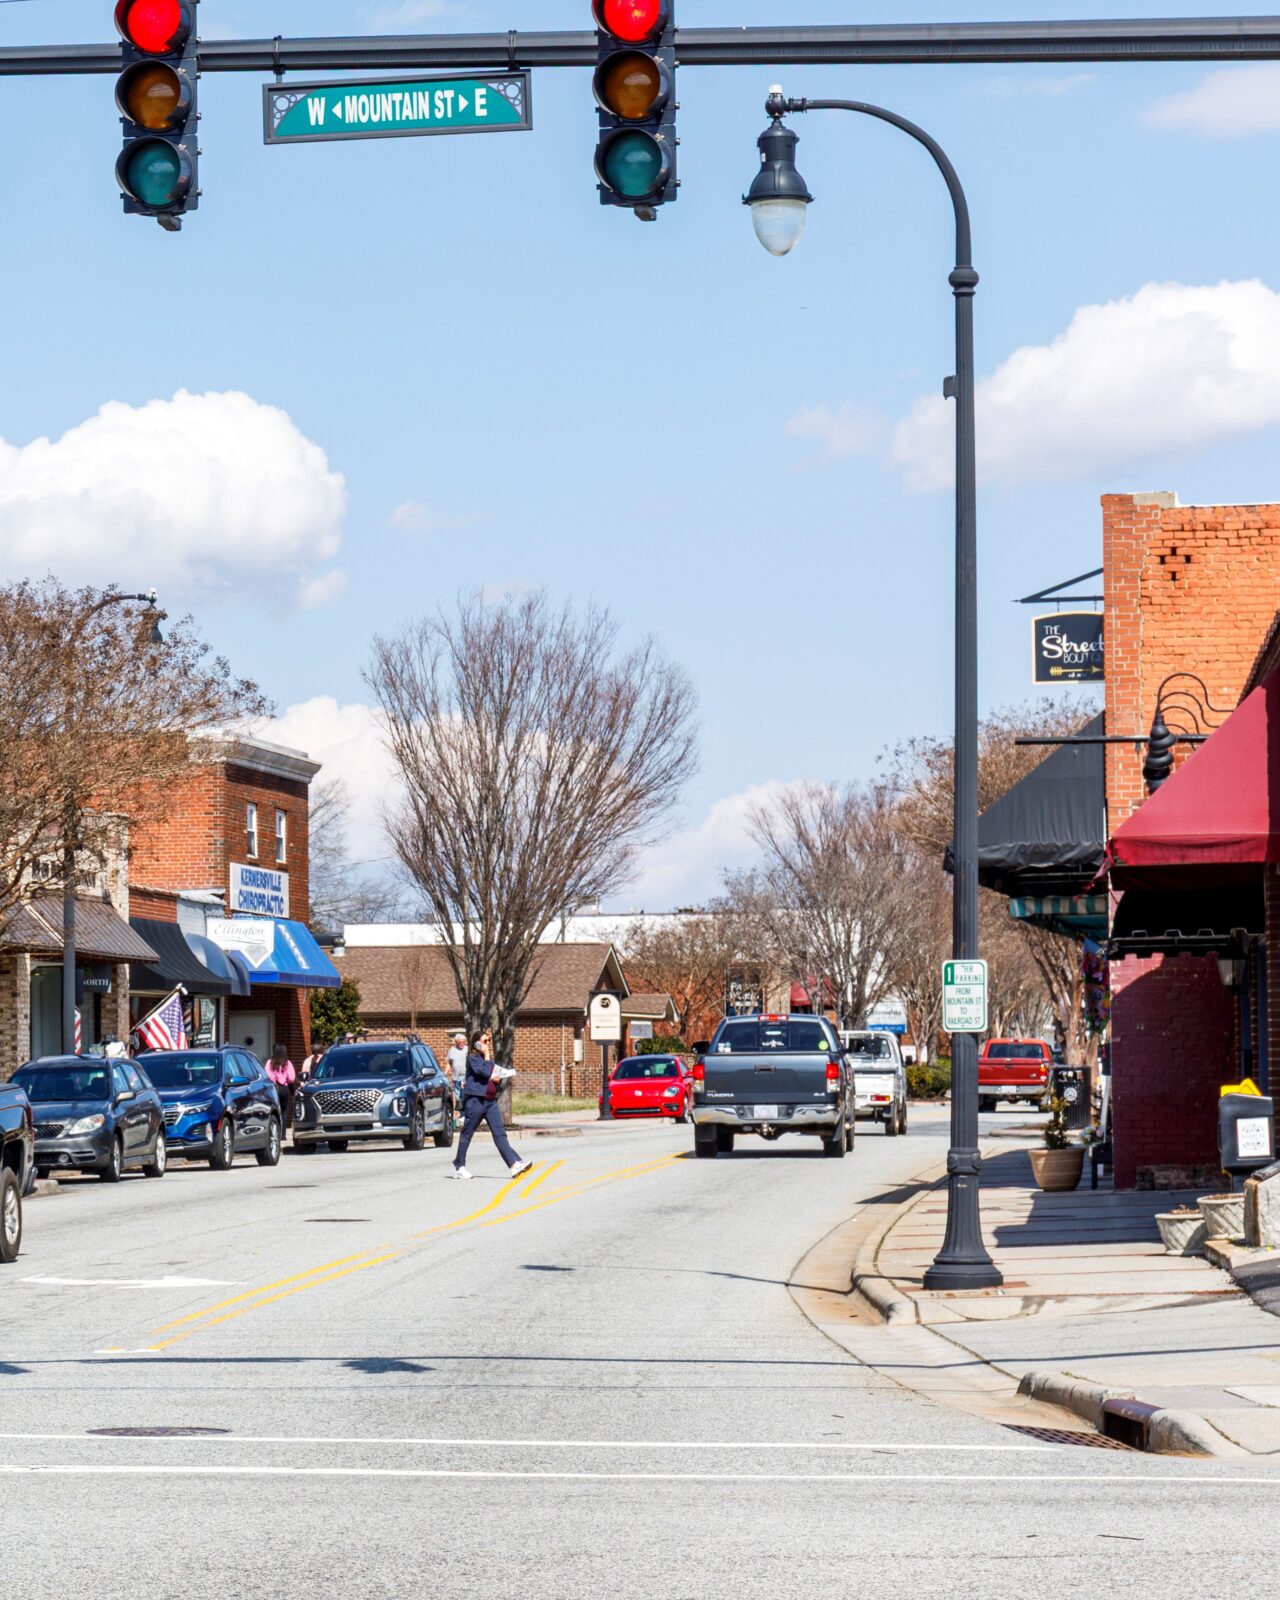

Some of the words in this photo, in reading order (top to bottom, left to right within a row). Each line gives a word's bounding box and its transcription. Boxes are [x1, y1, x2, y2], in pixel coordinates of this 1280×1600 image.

[307, 97, 326, 126] W
[344, 90, 430, 124] MOUNTAIN
[434, 89, 455, 119] ST
[474, 88, 487, 117] E
[1043, 625, 1061, 635] THE
[1041, 633, 1104, 659] Street
[240, 867, 282, 892] KERNERSVILLE
[238, 889, 284, 915] CHIROPRACTIC
[214, 922, 265, 937] Ellington
[947, 966, 952, 982] 1
[946, 997, 974, 1005] MOUNTAIN
[975, 997, 982, 1005] ST
